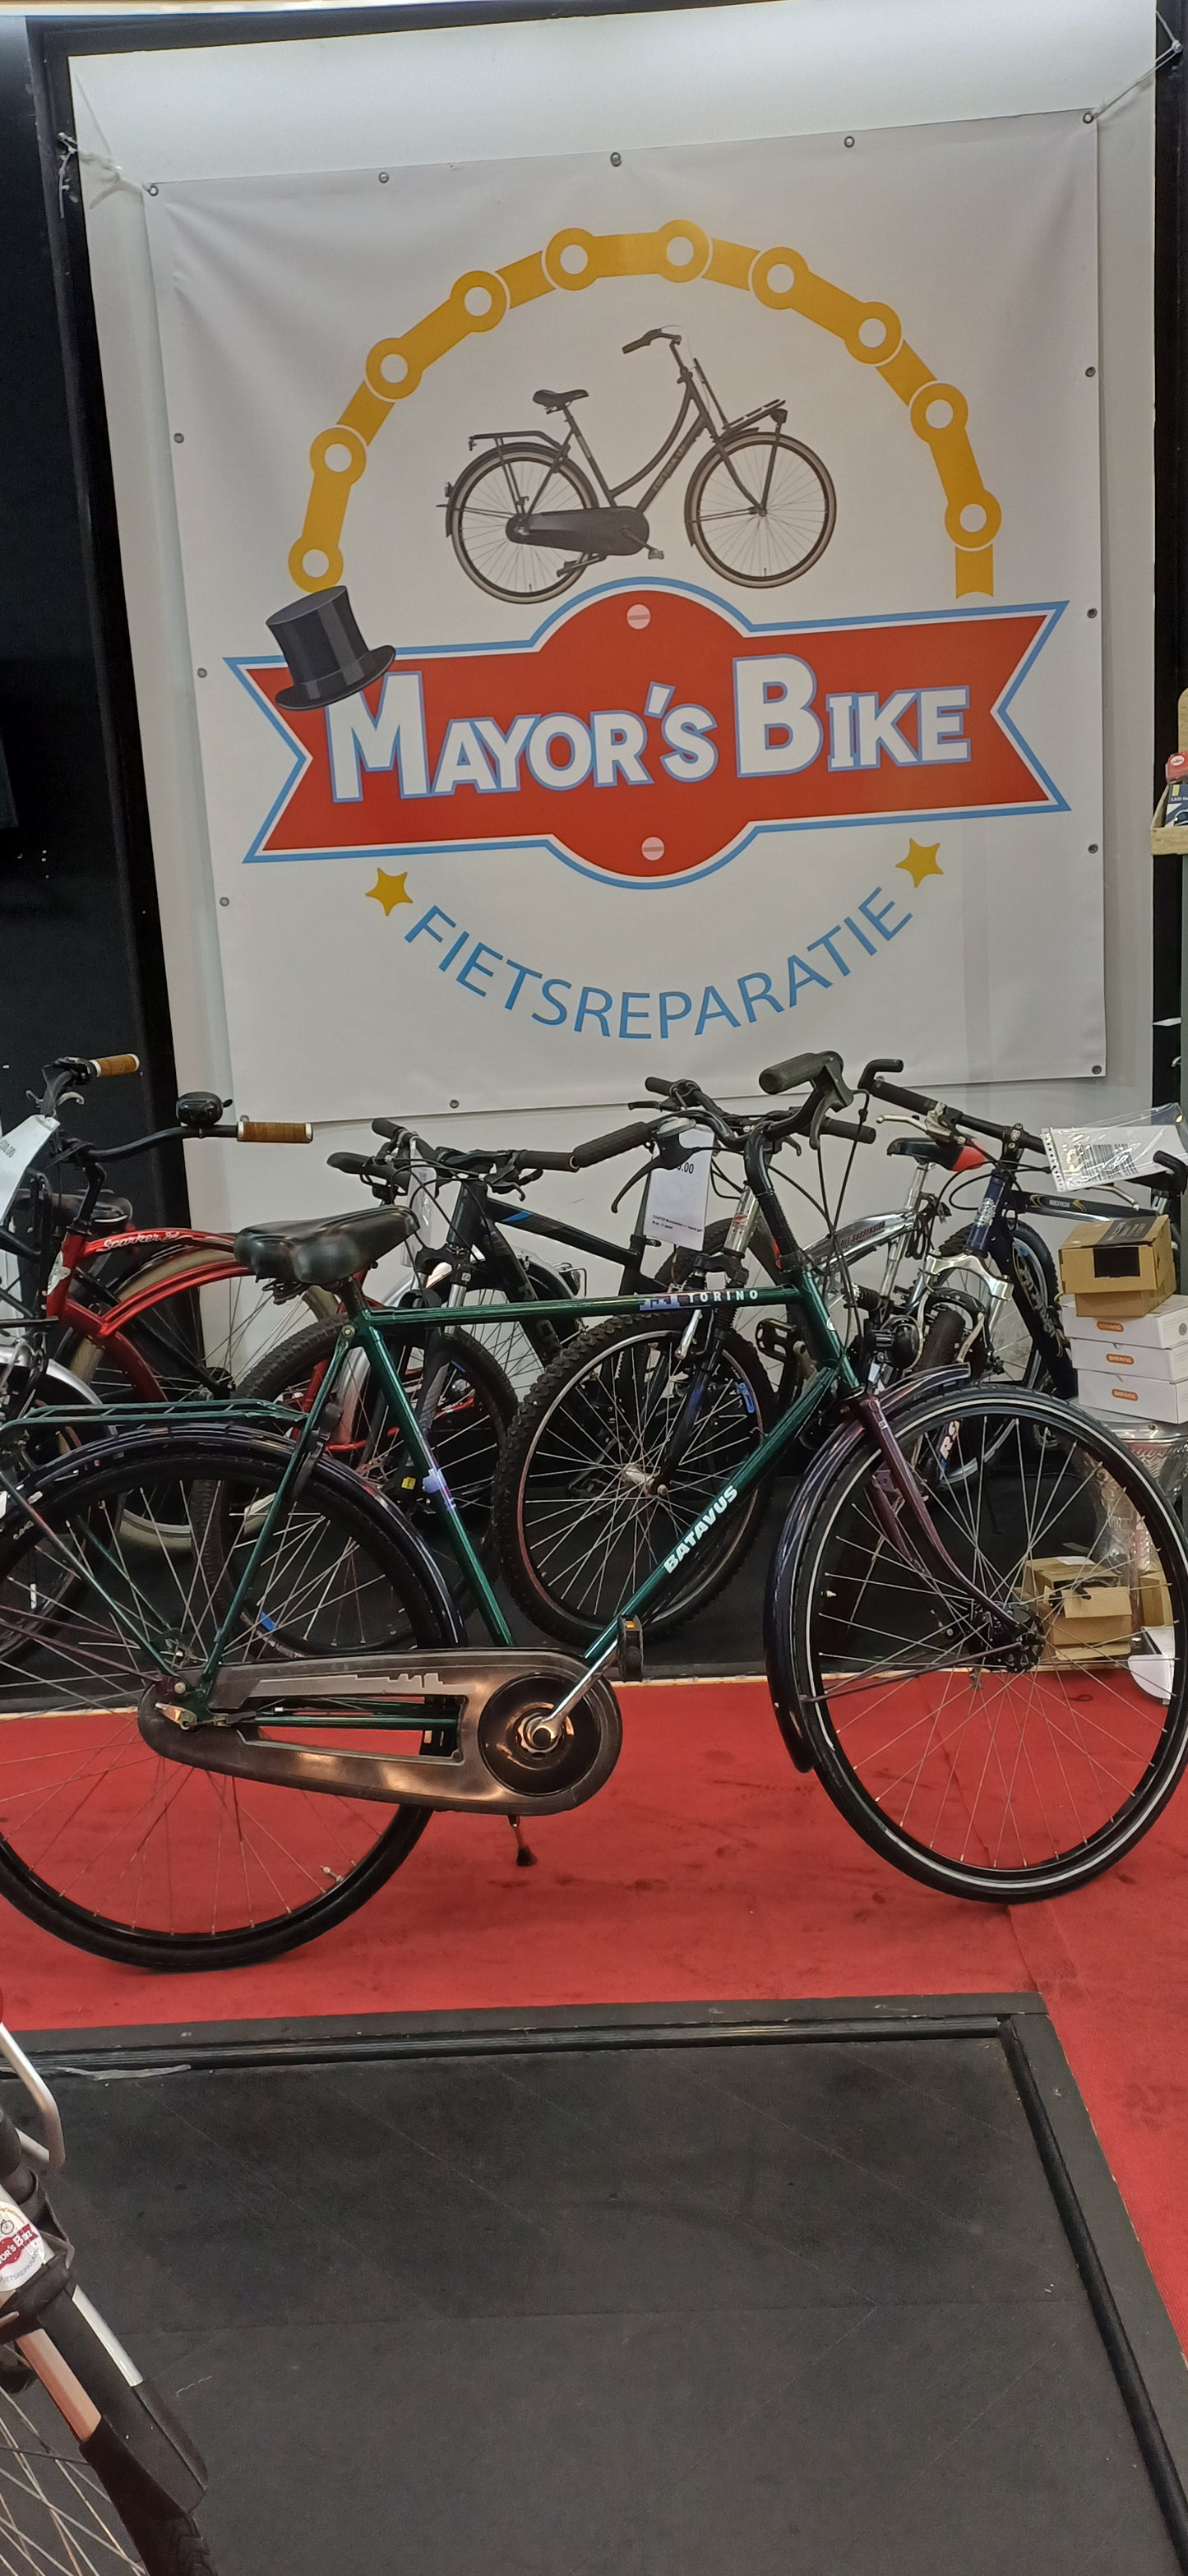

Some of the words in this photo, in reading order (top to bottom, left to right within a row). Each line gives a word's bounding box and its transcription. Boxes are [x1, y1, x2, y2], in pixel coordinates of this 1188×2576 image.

[404, 885, 914, 1041] FIETSREPARATIE
[687, 1290, 759, 1304] TORINO
[663, 1484, 738, 1574] BATAVUS
